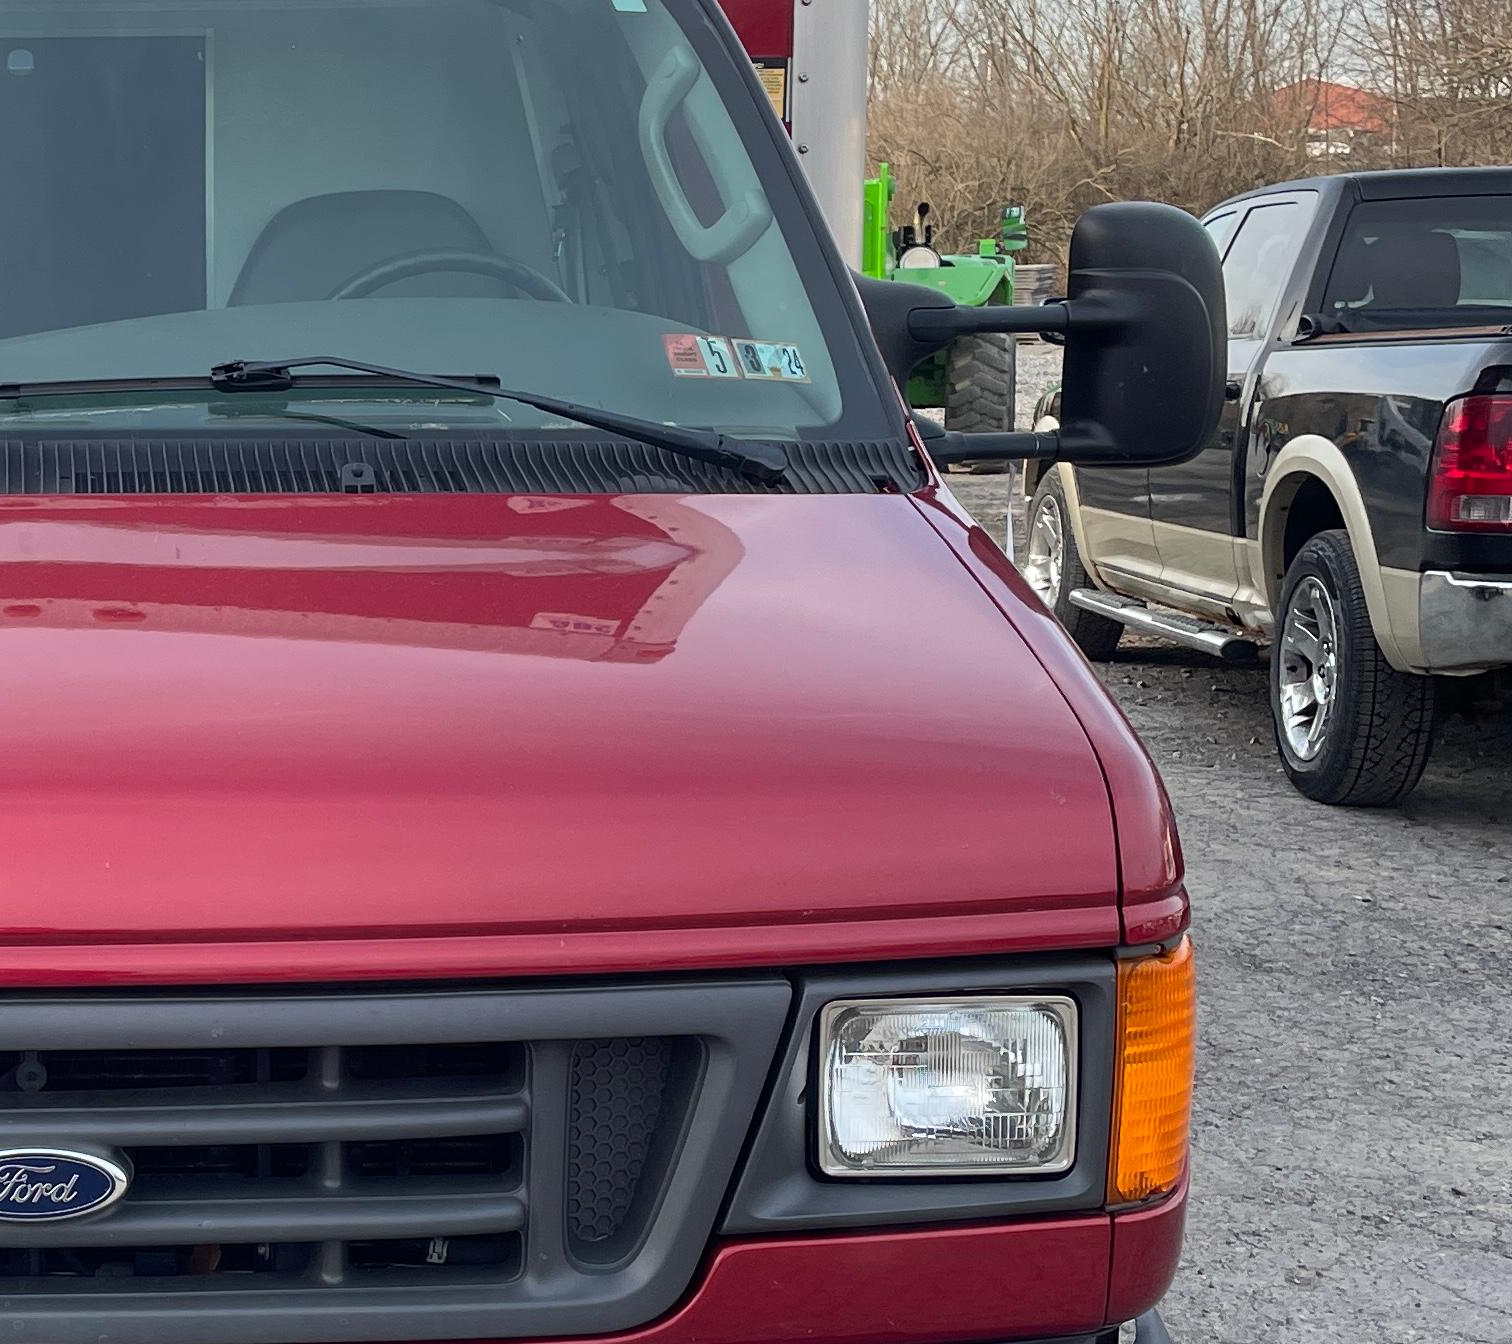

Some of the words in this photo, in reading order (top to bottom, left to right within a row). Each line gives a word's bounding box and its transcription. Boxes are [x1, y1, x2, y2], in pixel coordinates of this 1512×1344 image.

[705, 338, 728, 374] 5
[743, 344, 762, 372] 3
[782, 347, 806, 376] 24
